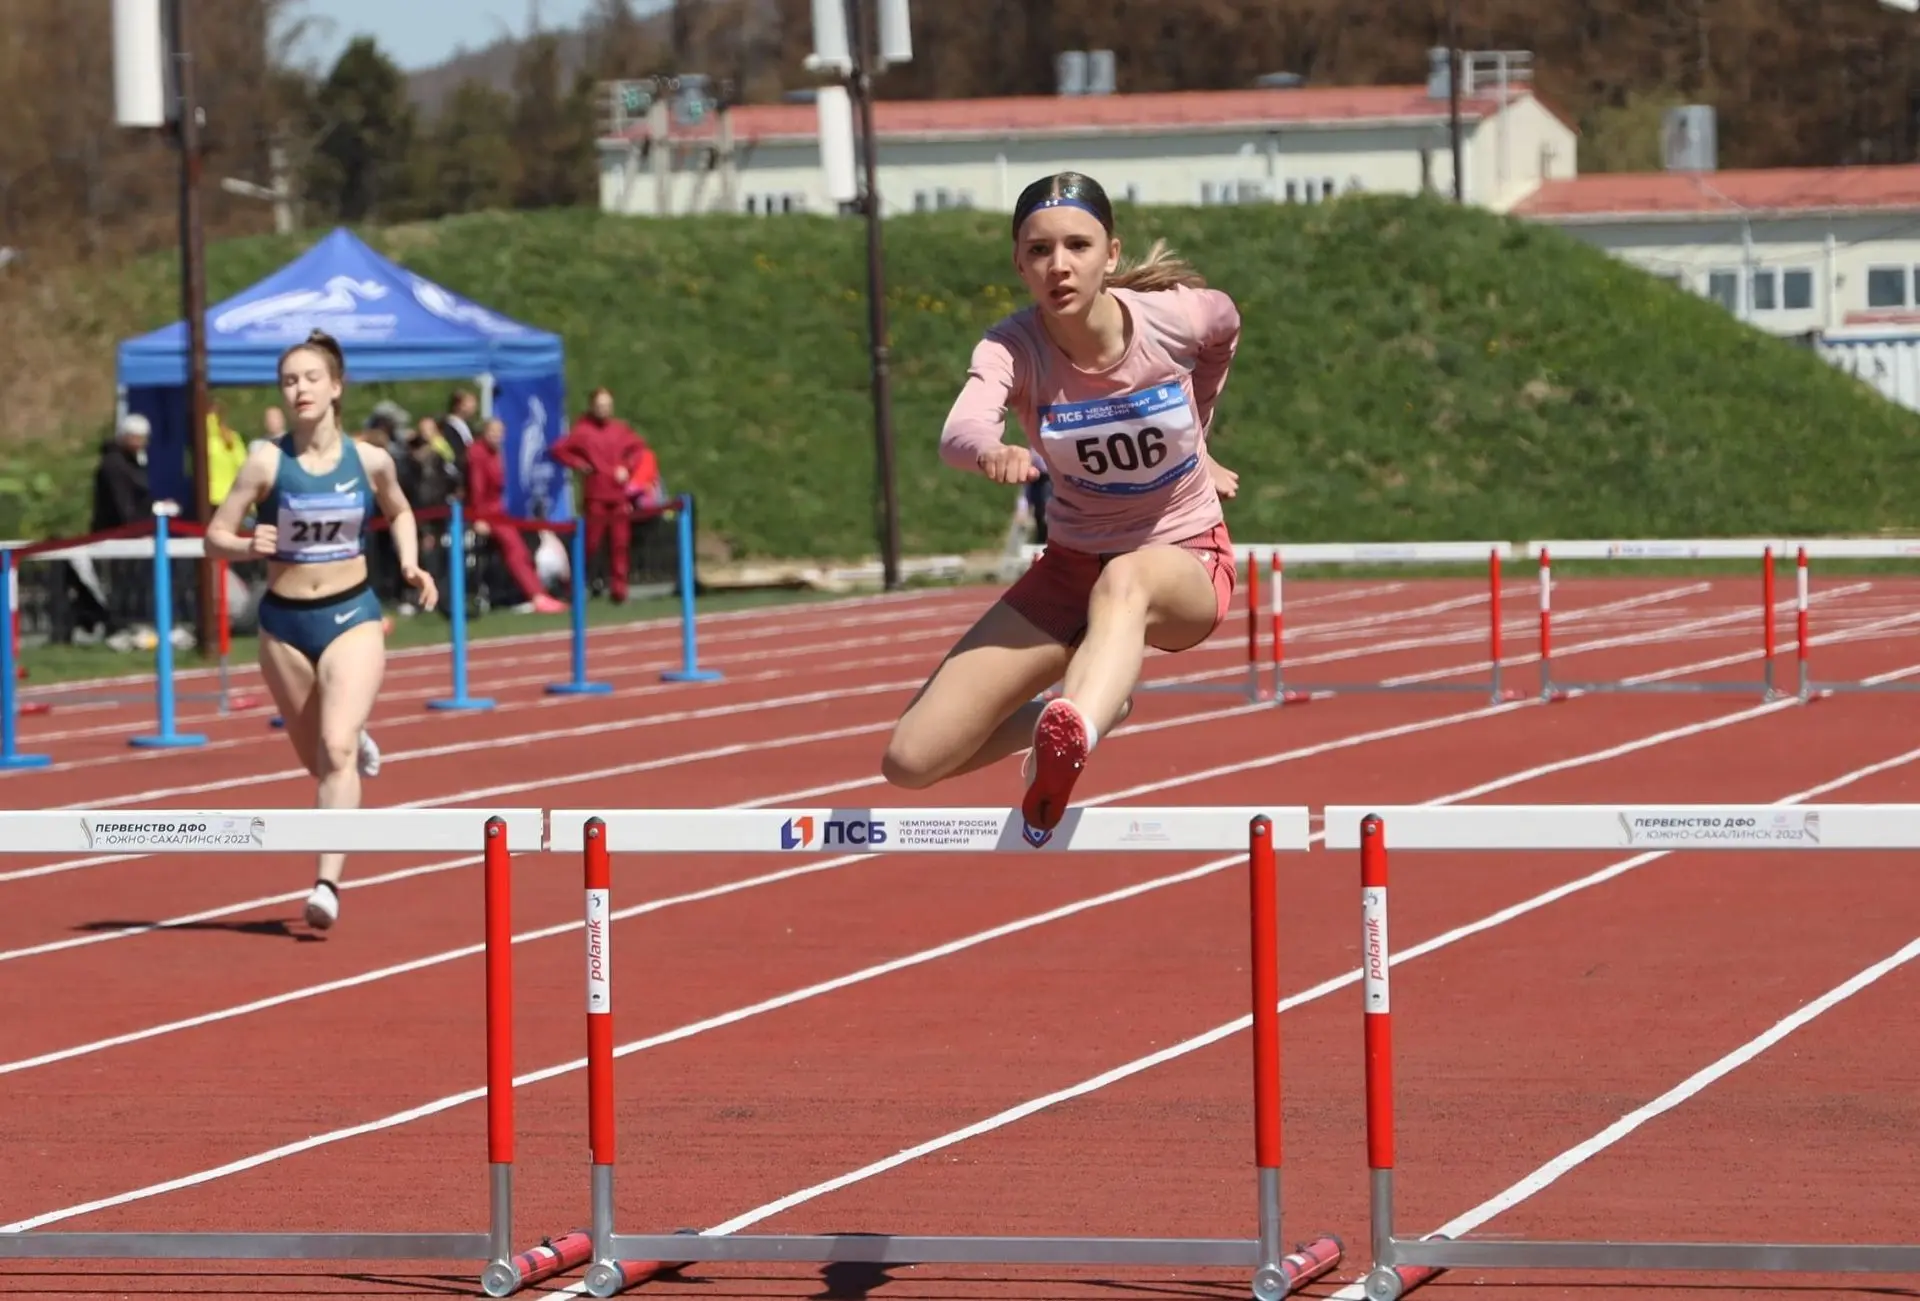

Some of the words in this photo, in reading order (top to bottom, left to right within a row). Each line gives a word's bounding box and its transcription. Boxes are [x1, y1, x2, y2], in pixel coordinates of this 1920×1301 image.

[1057, 411, 1083, 423] ПСБ
[1075, 427, 1168, 475] 506
[290, 520, 342, 542] 217
[95, 823, 175, 833] ПЕРВЕНСТВО
[177, 823, 207, 833] ДФО
[899, 819, 956, 827] ЧЕМПИОНАТ
[958, 819, 997, 827] РОССИИ
[1634, 817, 1721, 827] ПЕРВЕНСТВО
[1724, 818, 1756, 828] ДФО
[823, 820, 887, 844] ПСБ
[899, 828, 912, 836] ПО
[914, 827, 950, 836] ЛЕГКОЙ
[953, 828, 998, 836] АТЛЕТИКЕ
[1775, 829, 1804, 840] 2023
[105, 834, 221, 845] ЮЖНО-САХАЛИНСК
[224, 834, 250, 845] 2023
[908, 837, 970, 845] ПОМЕЩЕНИИ
[588, 919, 605, 982] polanik
[1365, 917, 1384, 981] polanik
